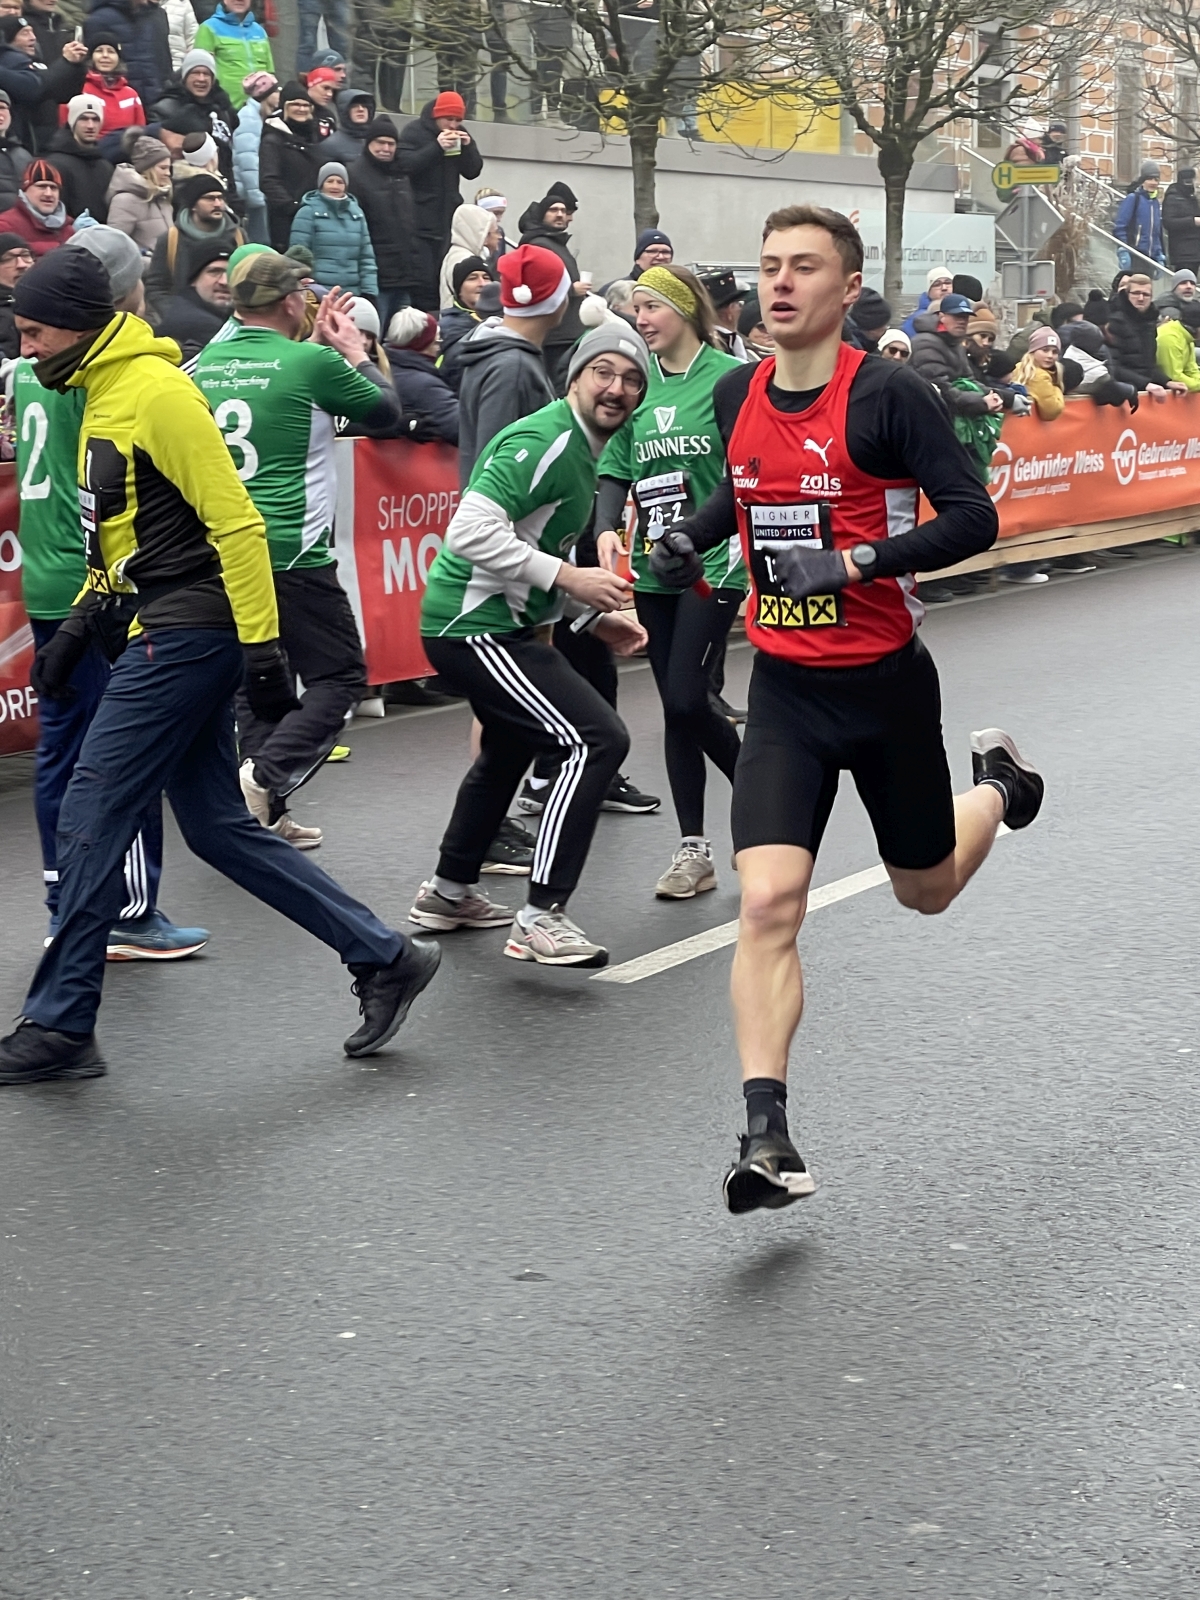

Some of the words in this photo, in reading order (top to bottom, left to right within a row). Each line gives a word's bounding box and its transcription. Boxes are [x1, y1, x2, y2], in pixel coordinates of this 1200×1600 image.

[998, 166, 1011, 185] H
[20, 402, 50, 500] 2
[214, 398, 258, 481] 3
[634, 435, 711, 463] GUINNESS
[1014, 453, 1073, 482] Gebrüder
[1073, 449, 1104, 474] Weiss
[1138, 440, 1186, 466] Gebrüder
[639, 475, 678, 488] AIGNER
[647, 501, 684, 528] 26-2
[754, 511, 810, 521] AIGNER
[755, 527, 813, 537] UNITEDOPTICS
